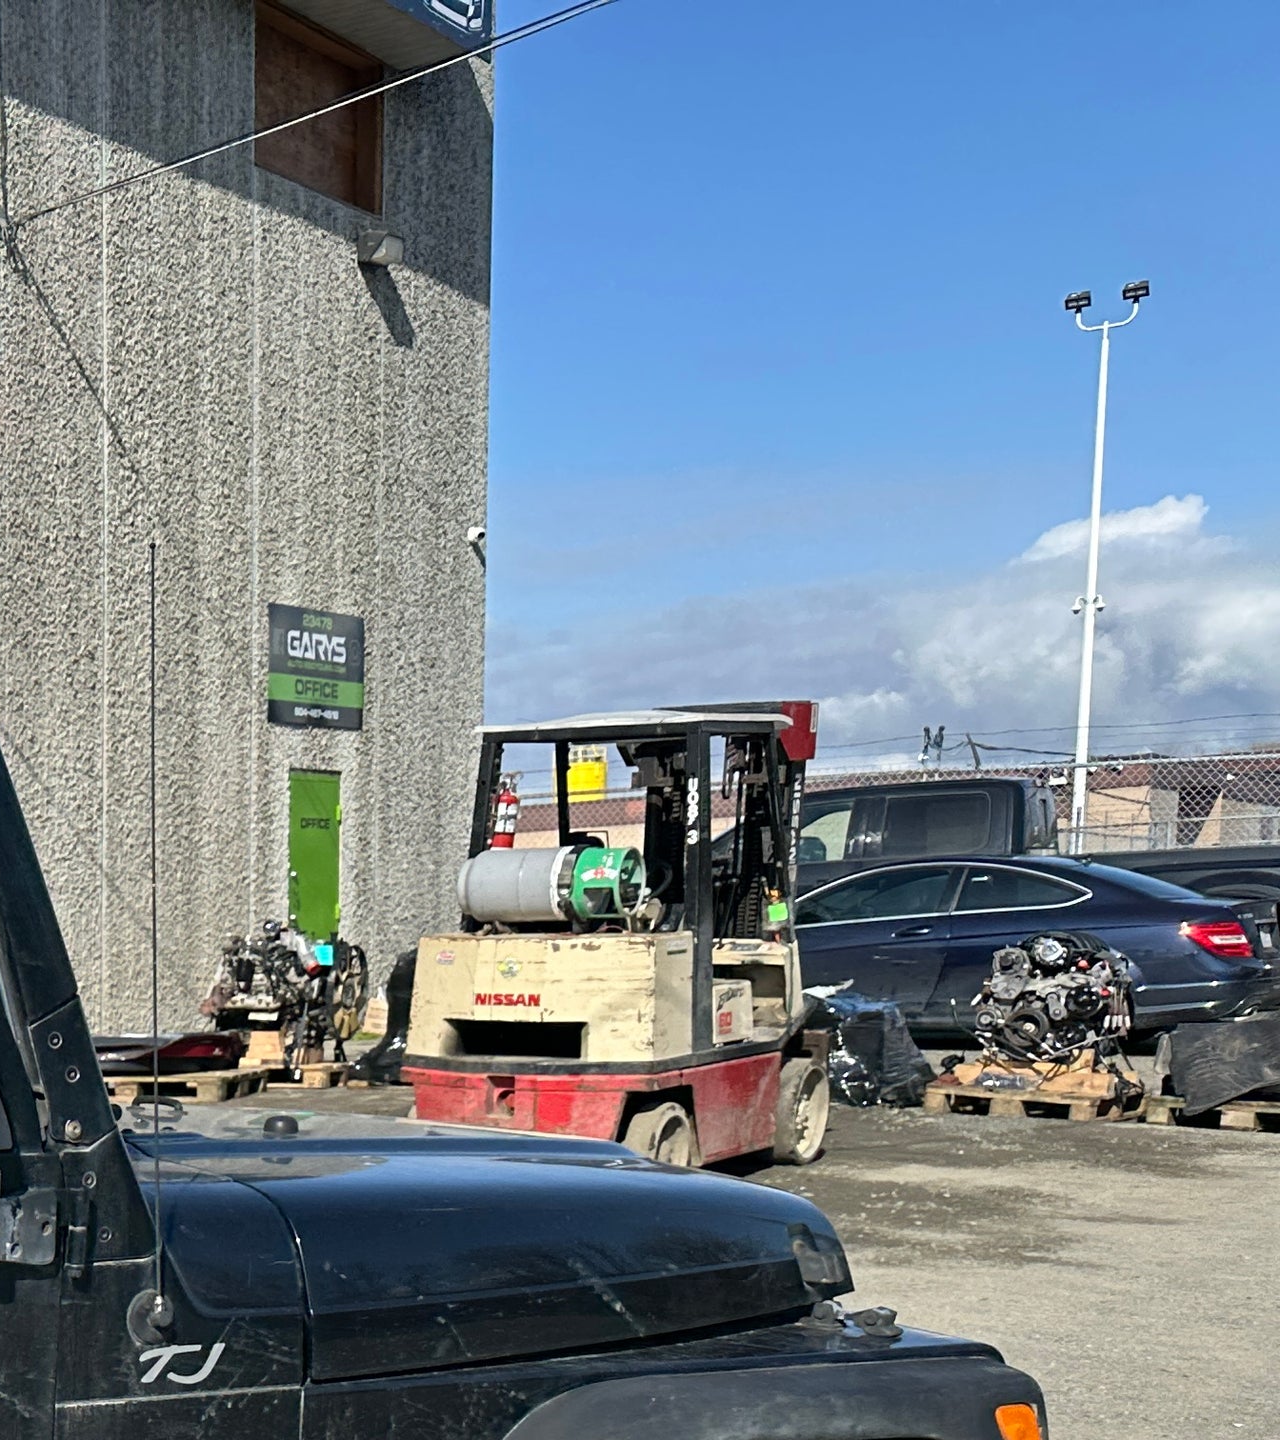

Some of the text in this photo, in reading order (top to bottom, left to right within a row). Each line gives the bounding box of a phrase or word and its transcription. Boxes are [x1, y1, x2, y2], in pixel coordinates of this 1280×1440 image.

[287, 629, 347, 664] GARYS
[295, 678, 339, 700] OFFICE
[300, 817, 330, 830] OFFICE
[475, 993, 541, 1007] NISSAN
[139, 1343, 226, 1384] TJ
